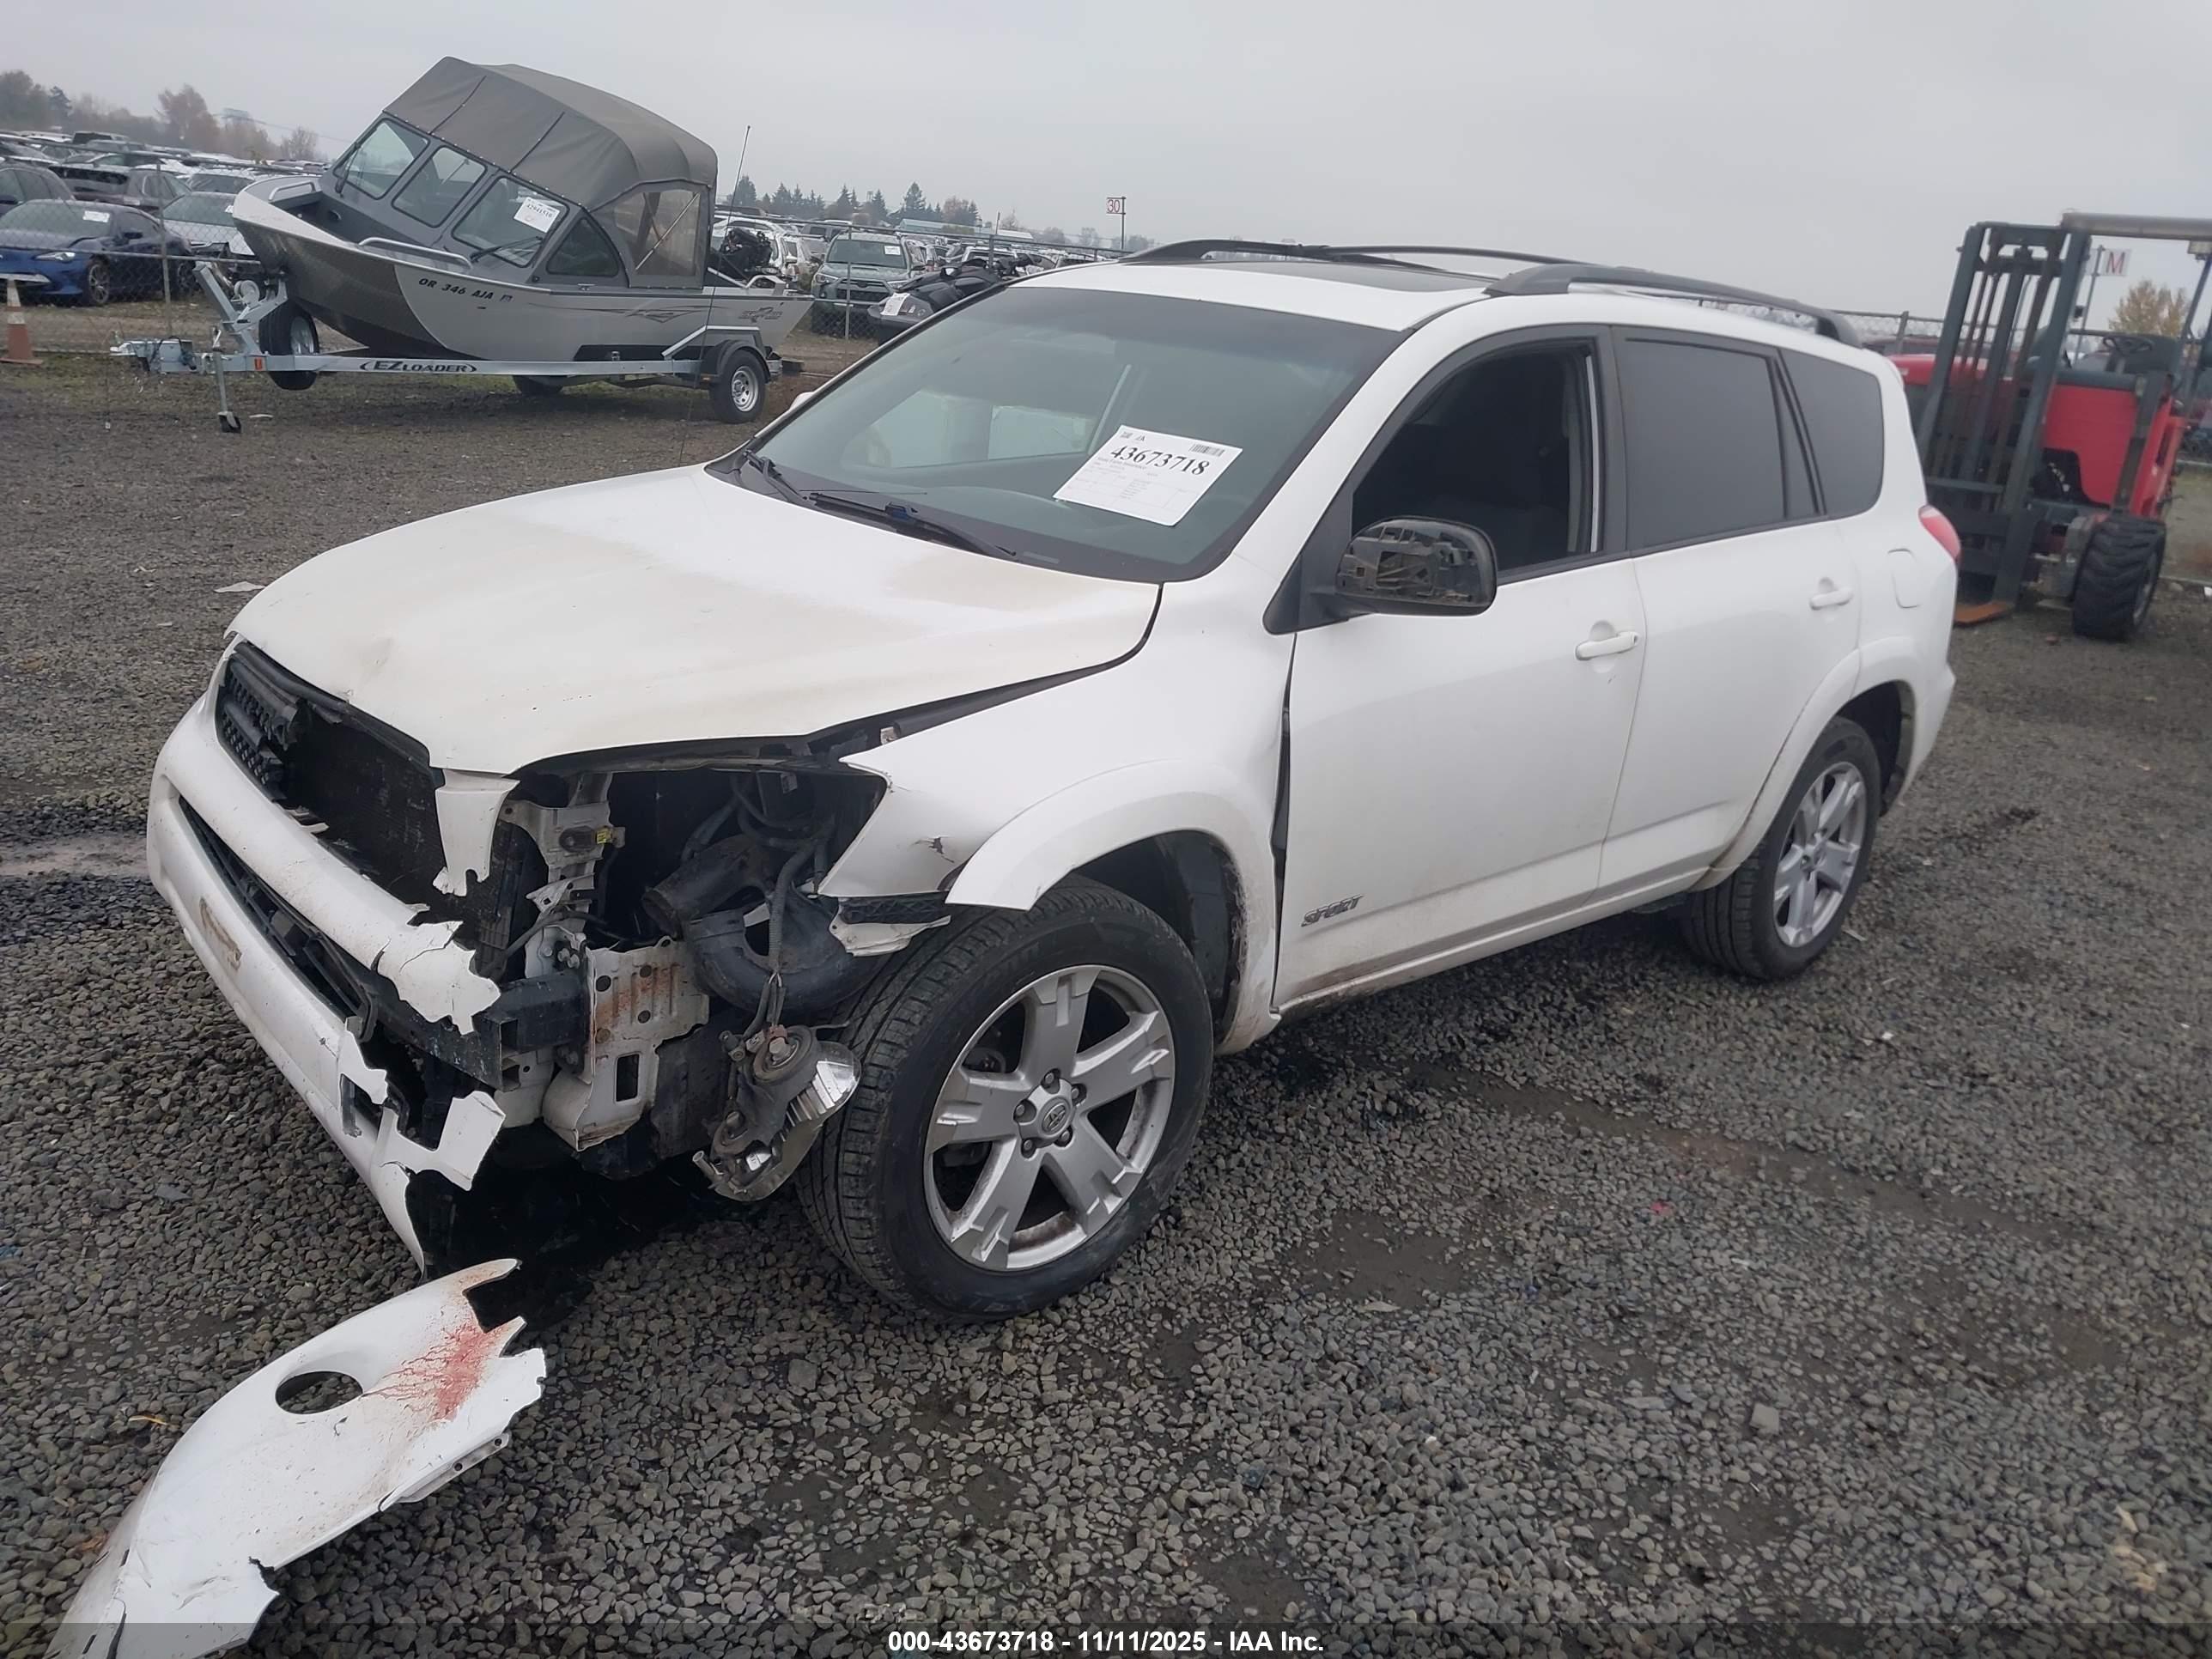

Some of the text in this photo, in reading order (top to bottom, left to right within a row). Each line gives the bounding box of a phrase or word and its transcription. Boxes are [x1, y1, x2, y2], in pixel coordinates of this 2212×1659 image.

[1108, 199, 1120, 213] 30
[2106, 252, 2125, 273] M
[418, 278, 437, 288] OR
[441, 284, 465, 295] 346
[1111, 446, 1210, 475] 43673718
